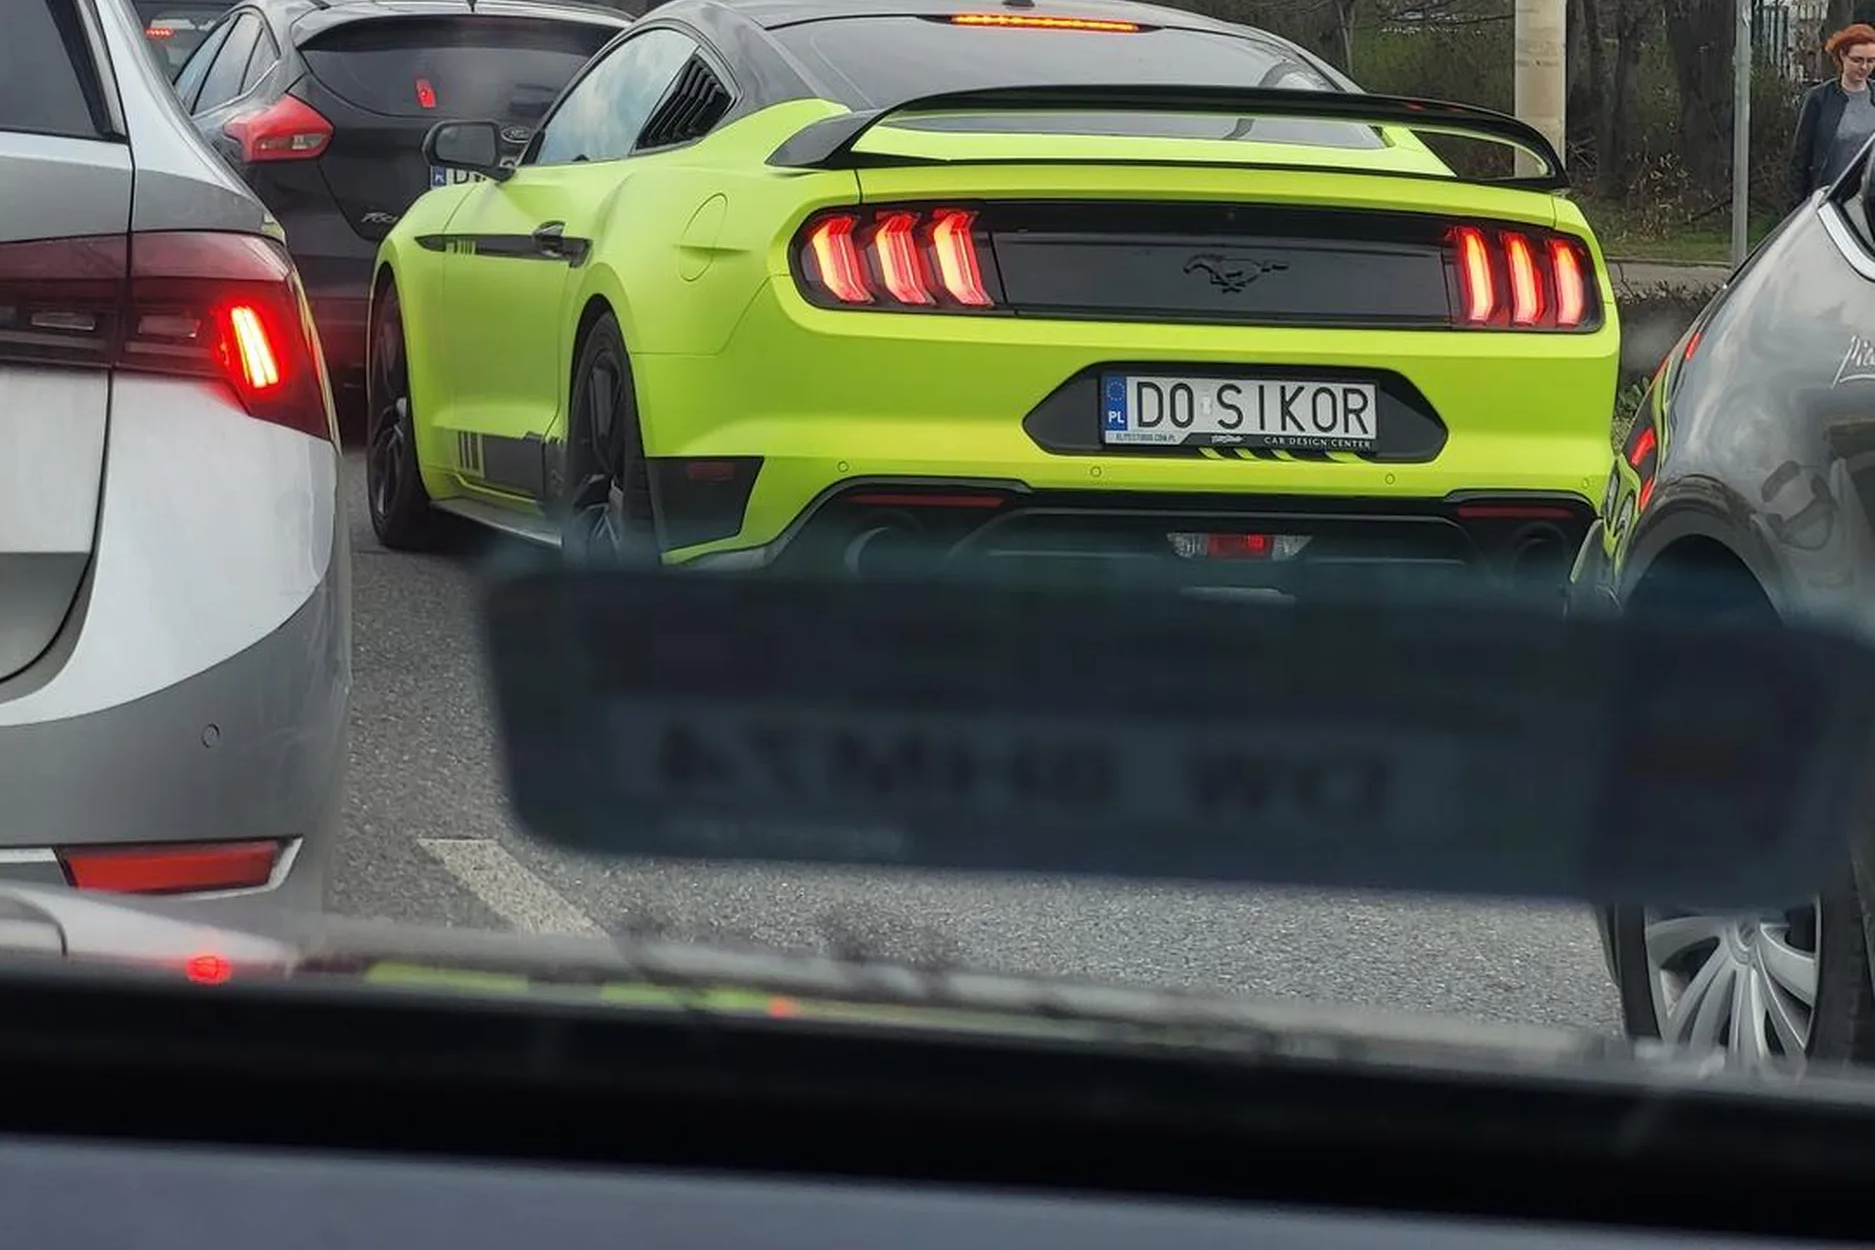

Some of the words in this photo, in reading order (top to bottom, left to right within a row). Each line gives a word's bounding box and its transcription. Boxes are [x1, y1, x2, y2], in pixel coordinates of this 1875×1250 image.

[1216, 383, 1369, 435] SIKOR
[1108, 410, 1125, 424] PL
[1263, 436, 1285, 445] CAR
[1289, 437, 1328, 447] DESIGN
[1331, 438, 1372, 449] CENTER
